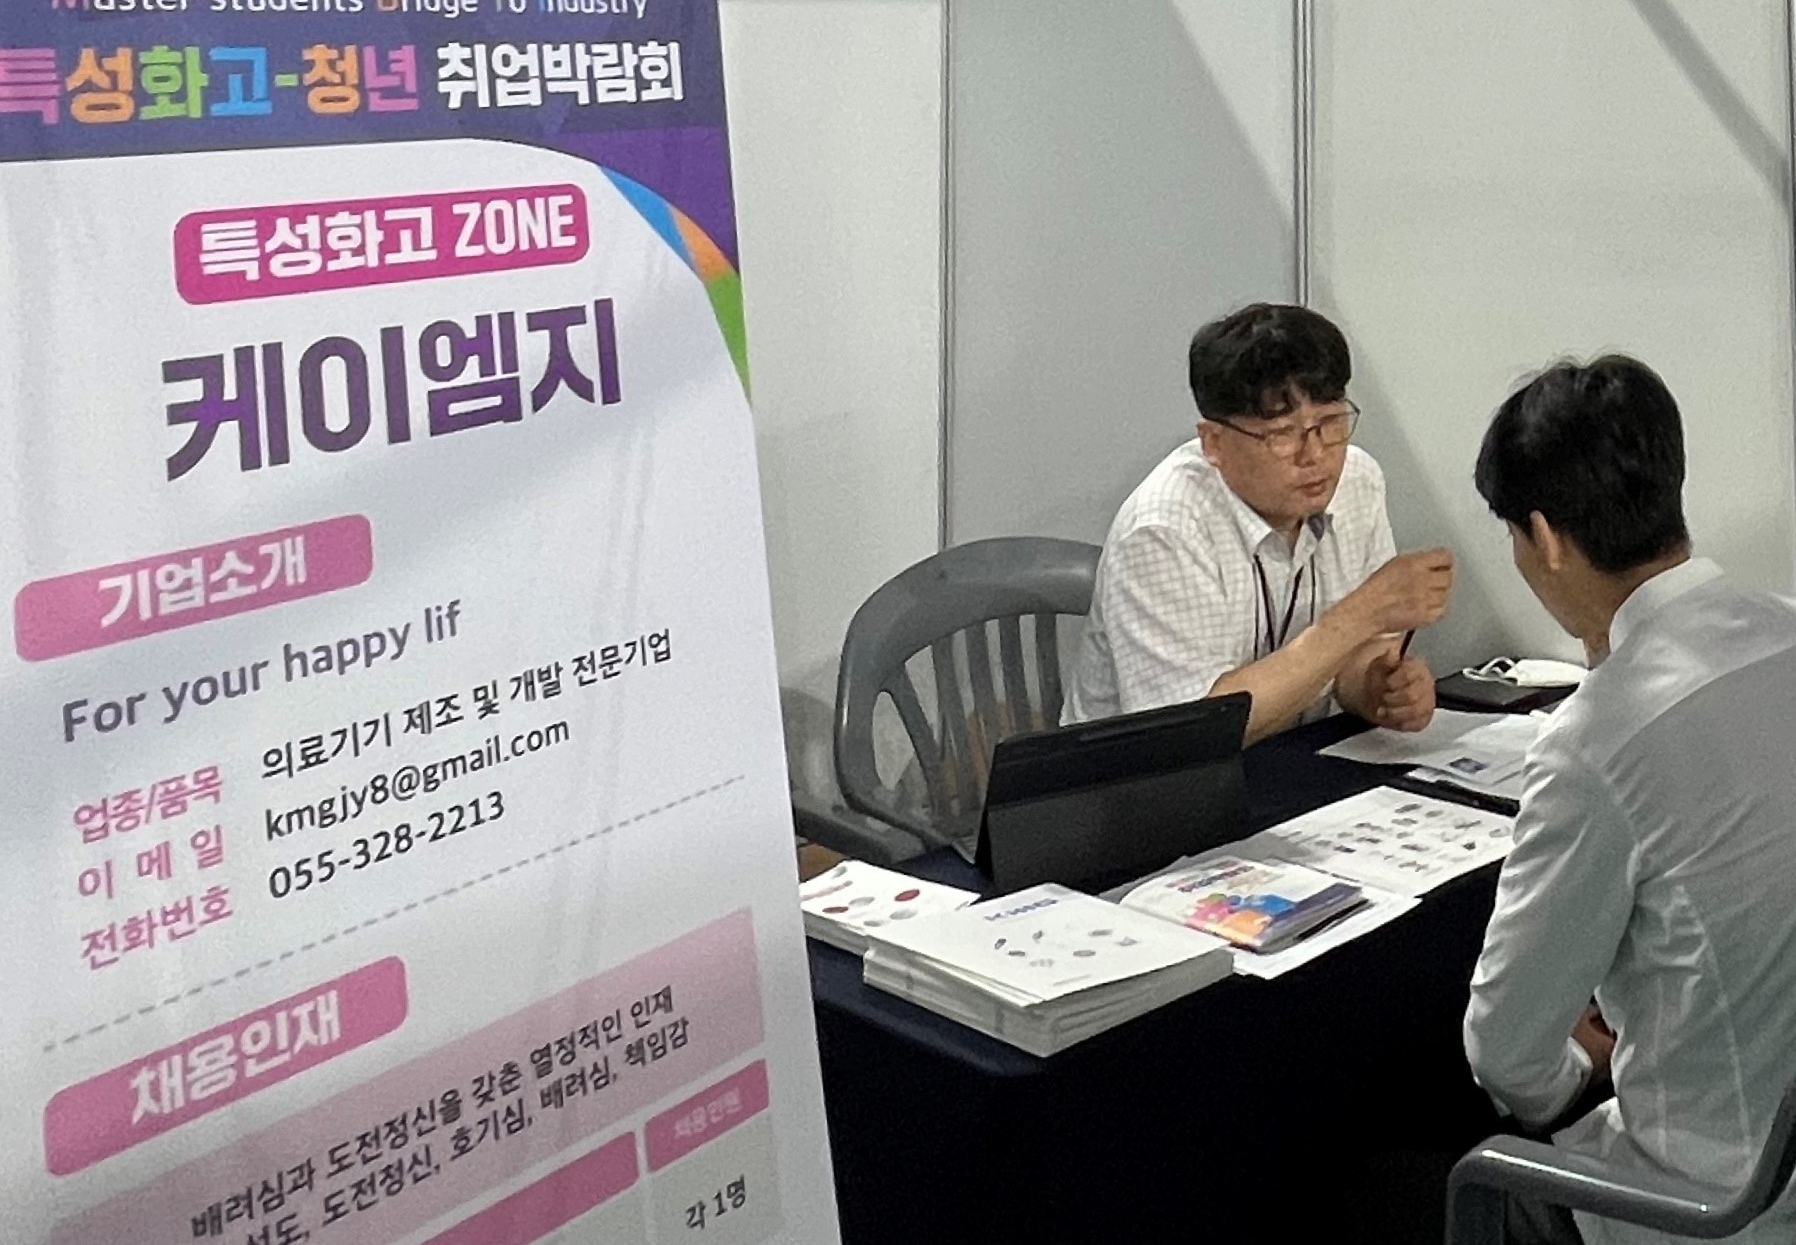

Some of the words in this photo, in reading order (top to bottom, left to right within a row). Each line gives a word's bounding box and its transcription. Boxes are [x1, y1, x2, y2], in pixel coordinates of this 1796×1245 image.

[0, 44, 419, 124] 특성화고-청년
[437, 41, 684, 109] 취업박람회
[200, 206, 438, 281] 특성화고
[452, 194, 577, 256] ZONE
[161, 297, 622, 482] 케이엠지
[98, 537, 308, 629] 기업소개
[62, 692, 147, 742] For
[162, 660, 270, 723] your
[284, 623, 411, 682] happy
[424, 599, 461, 643] lif
[73, 765, 225, 845] 업종/품목
[261, 712, 393, 779] 의료기기
[403, 693, 464, 735] 제조
[472, 679, 500, 720] 및
[509, 661, 563, 702] 개발
[571, 628, 672, 687] 전문기업
[265, 720, 570, 841] kmgjy8@gmail.com
[81, 885, 233, 970] 전화번호
[269, 790, 505, 898] 055-328-2213
[130, 989, 342, 1127] 채용인재
[191, 1157, 316, 1239] 배려심과
[326, 1089, 463, 1179] 도전정신을
[472, 1060, 522, 1107] 갖춘
[530, 1009, 622, 1080] 열정적인
[630, 984, 674, 1030] 인재
[322, 1145, 441, 1227] 도전정신,
[450, 1099, 533, 1162] 호기심,
[540, 1056, 618, 1109] 배려심,
[625, 1016, 690, 1067] 책임감
[685, 1200, 707, 1230] 각
[714, 1173, 746, 1218] 1명
